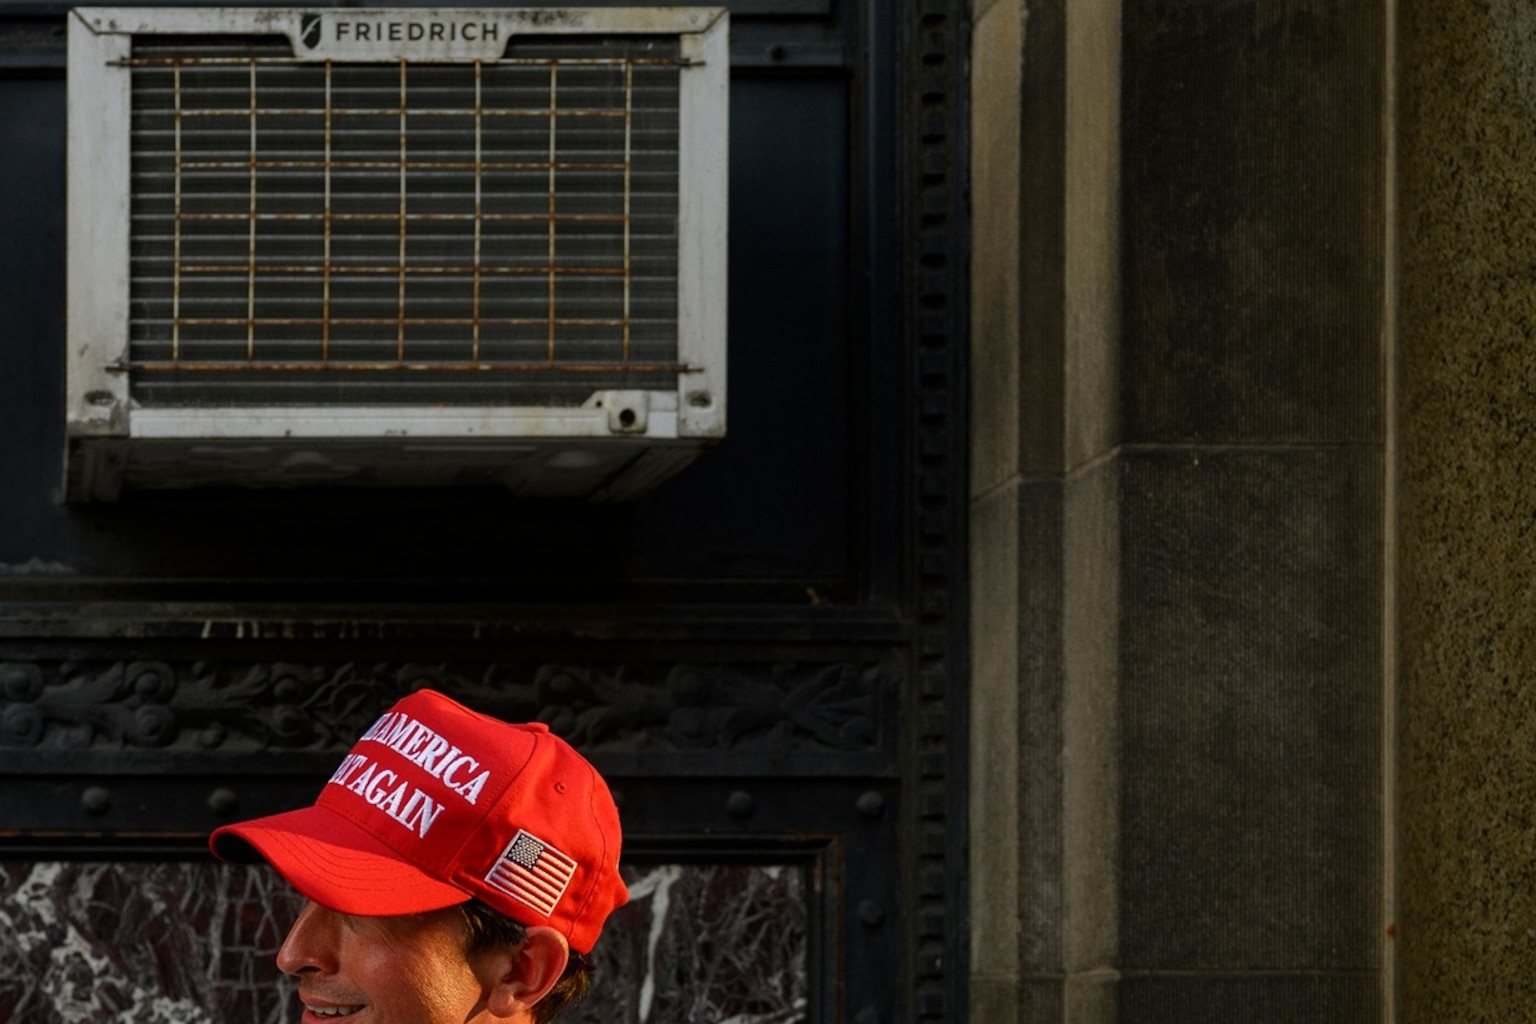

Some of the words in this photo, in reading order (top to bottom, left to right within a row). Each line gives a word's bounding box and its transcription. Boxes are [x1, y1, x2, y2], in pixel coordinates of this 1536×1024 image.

[336, 22, 498, 41] FRIEDRICH
[372, 711, 491, 806] AMERICA
[346, 761, 445, 839] AGAIN
